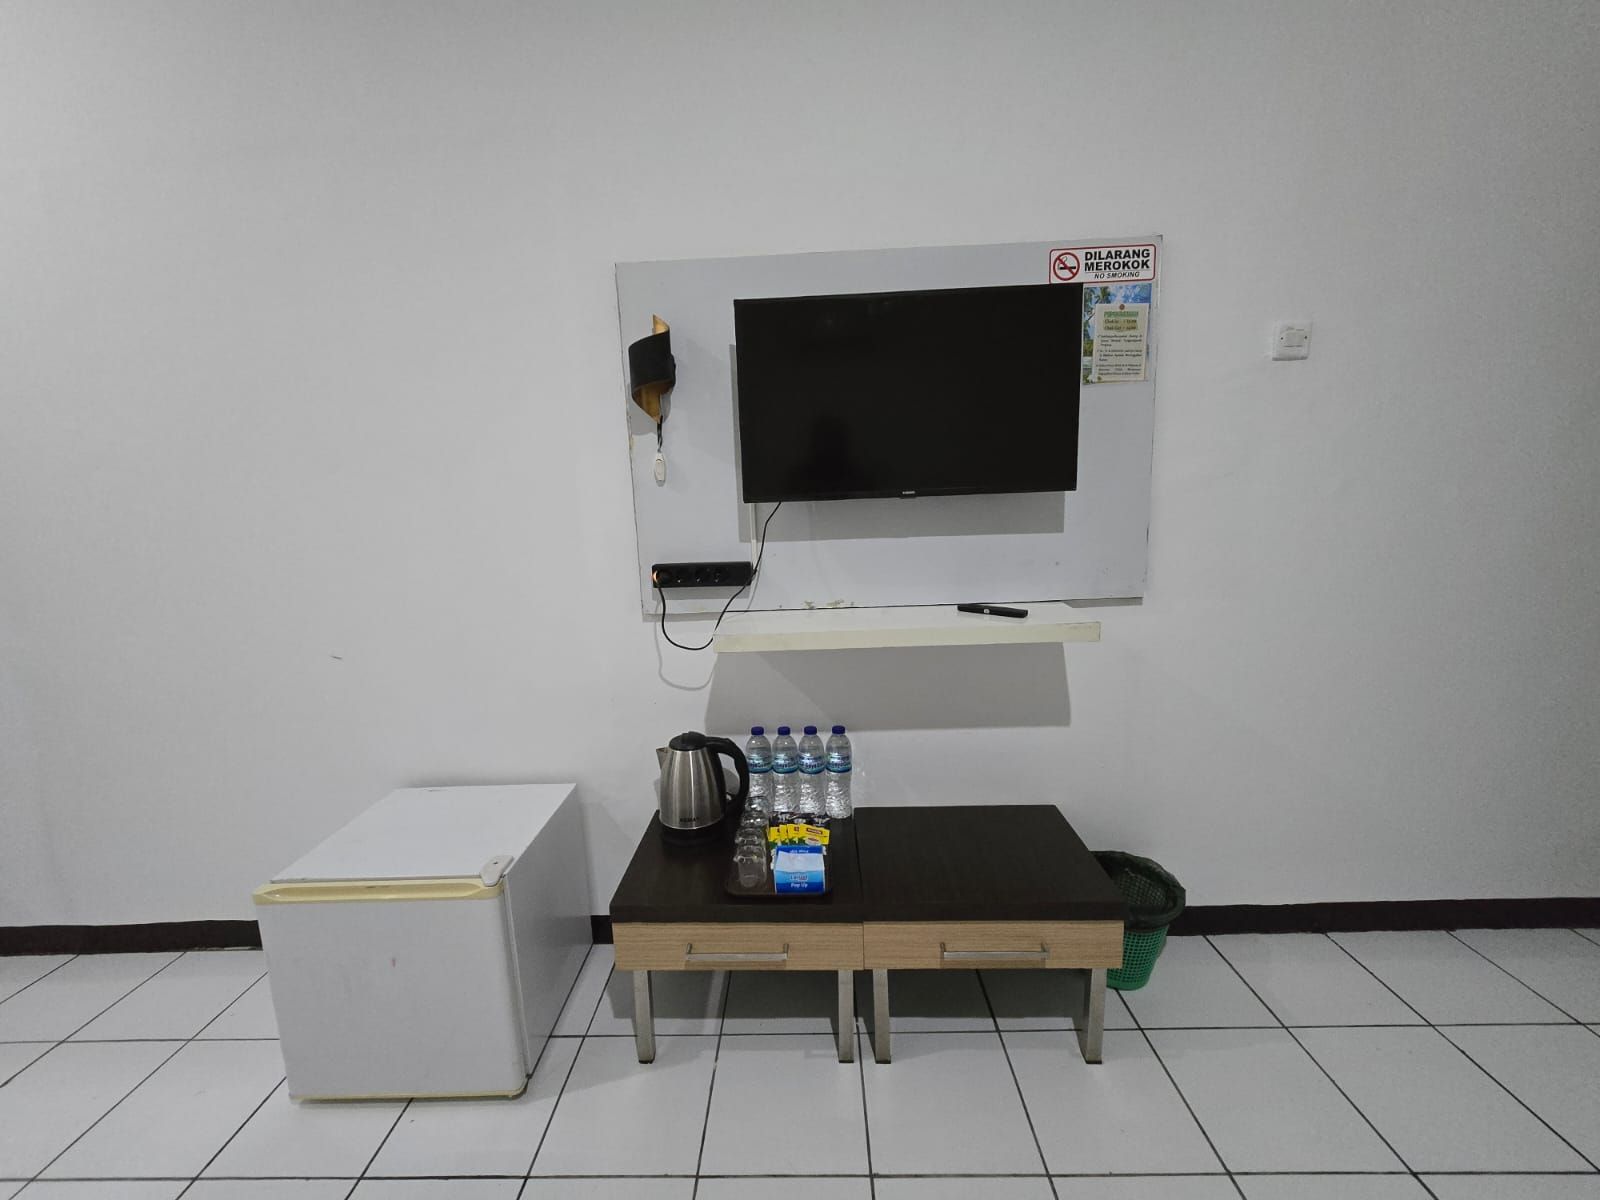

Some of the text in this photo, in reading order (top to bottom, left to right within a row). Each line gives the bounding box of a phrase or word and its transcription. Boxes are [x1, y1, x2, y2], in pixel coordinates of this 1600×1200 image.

[1084, 248, 1151, 261] DILARANG
[1084, 259, 1150, 272] MEROKOK
[1106, 271, 1140, 279] SMOKING
